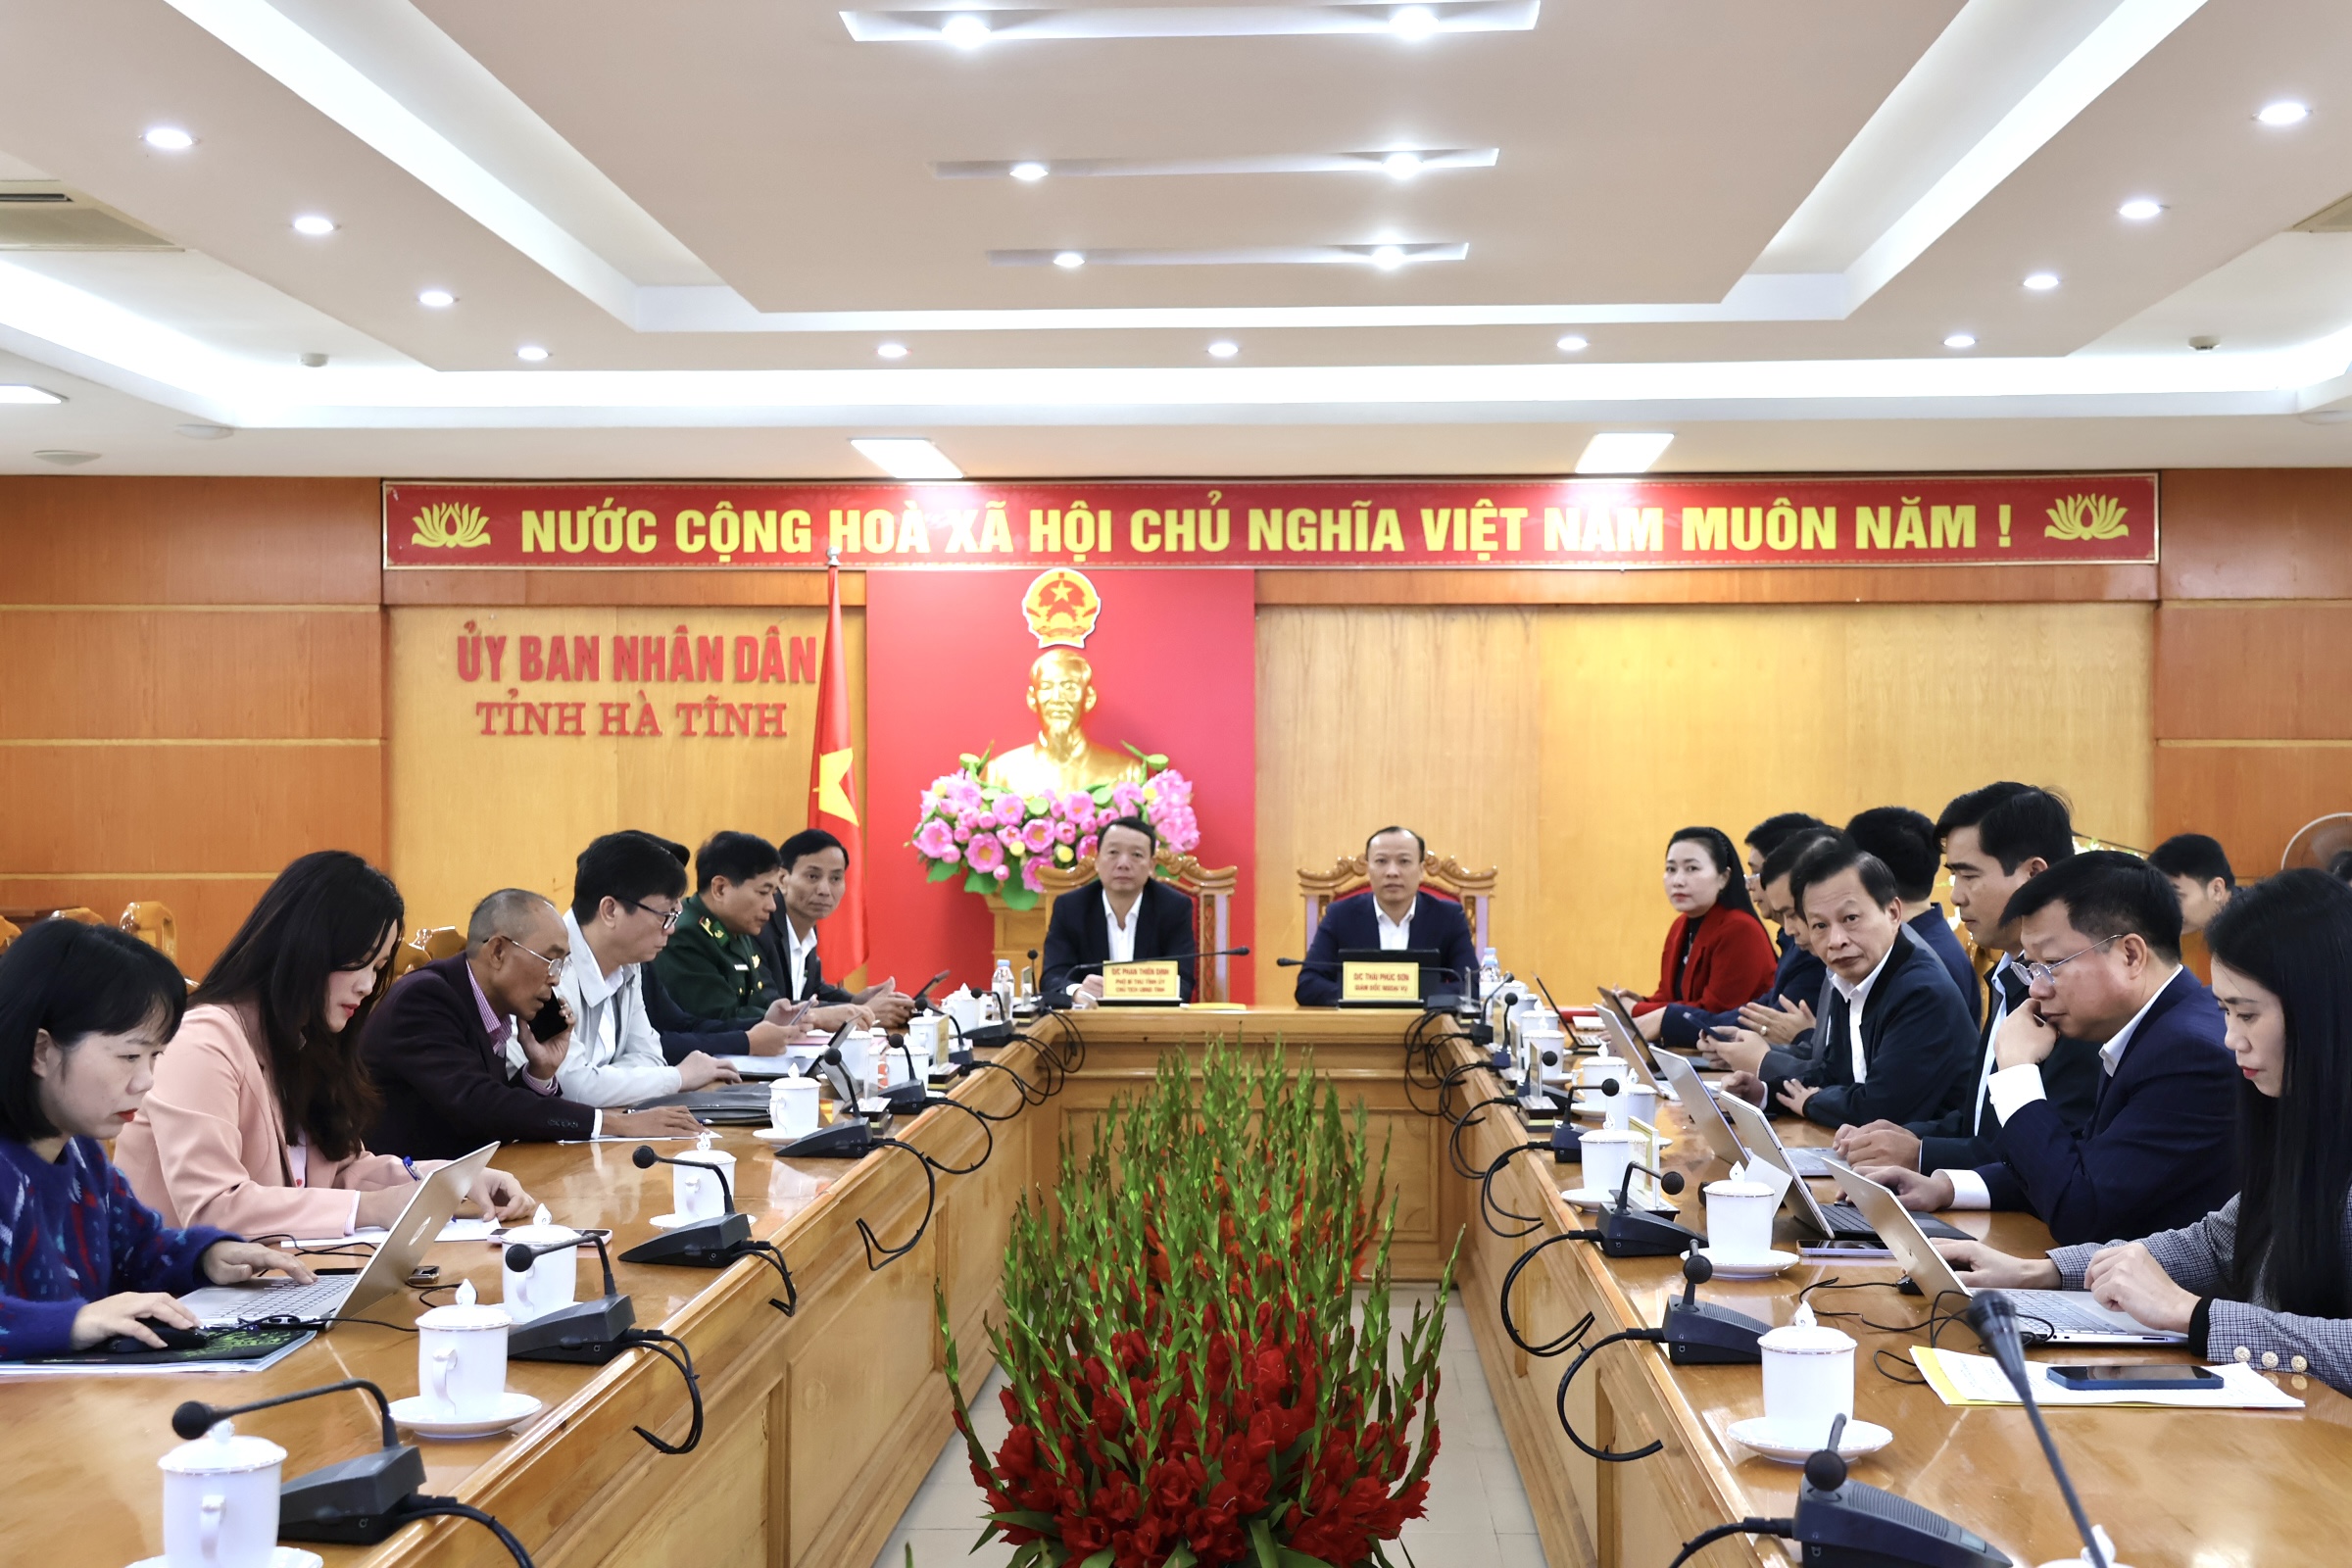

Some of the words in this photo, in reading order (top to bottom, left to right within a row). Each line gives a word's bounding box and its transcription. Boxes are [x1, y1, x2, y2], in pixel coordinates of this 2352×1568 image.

[522, 498, 658, 554] NƯỚC
[675, 501, 811, 563] CỘNG
[828, 501, 931, 554] HOÀ
[945, 501, 1014, 554] XÃ
[1029, 500, 1112, 563] HỘI
[1130, 490, 1230, 554] CHỦ
[1248, 500, 1405, 553] NGHĨA
[1421, 498, 1529, 562] VIỆT
[1544, 507, 1664, 553] NAM
[1681, 497, 1838, 552] MUÔN
[1854, 496, 1977, 550] NĂM
[1998, 504, 2012, 548] !
[457, 620, 507, 683] ỦY
[519, 635, 600, 683] BAN
[613, 625, 723, 683] NHÂN
[734, 625, 816, 684] DÂN
[476, 688, 587, 737] TỈNH
[599, 689, 662, 738] HÀ
[676, 694, 787, 738] TĨNH
